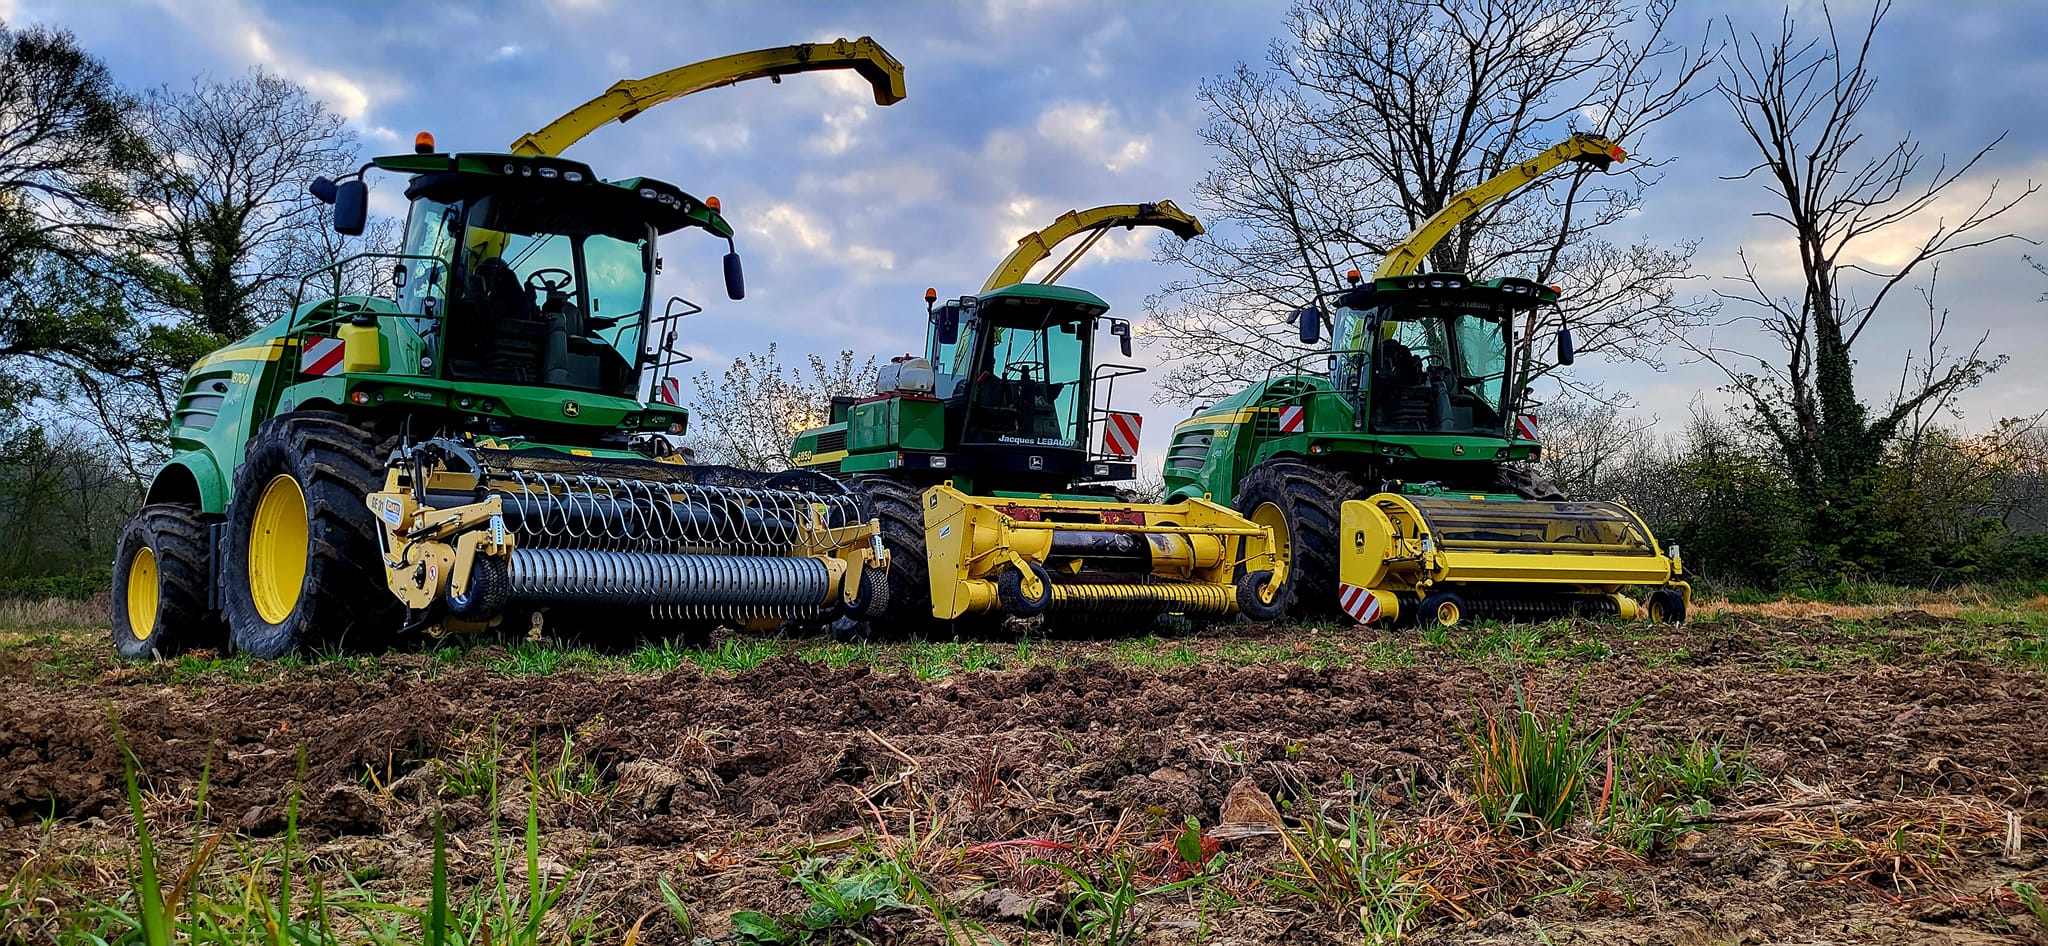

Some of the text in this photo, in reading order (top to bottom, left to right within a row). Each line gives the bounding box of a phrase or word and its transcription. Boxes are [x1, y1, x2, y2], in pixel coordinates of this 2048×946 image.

[231, 372, 250, 384] 8700
[998, 434, 1075, 447] Jacques LEBAUDY
